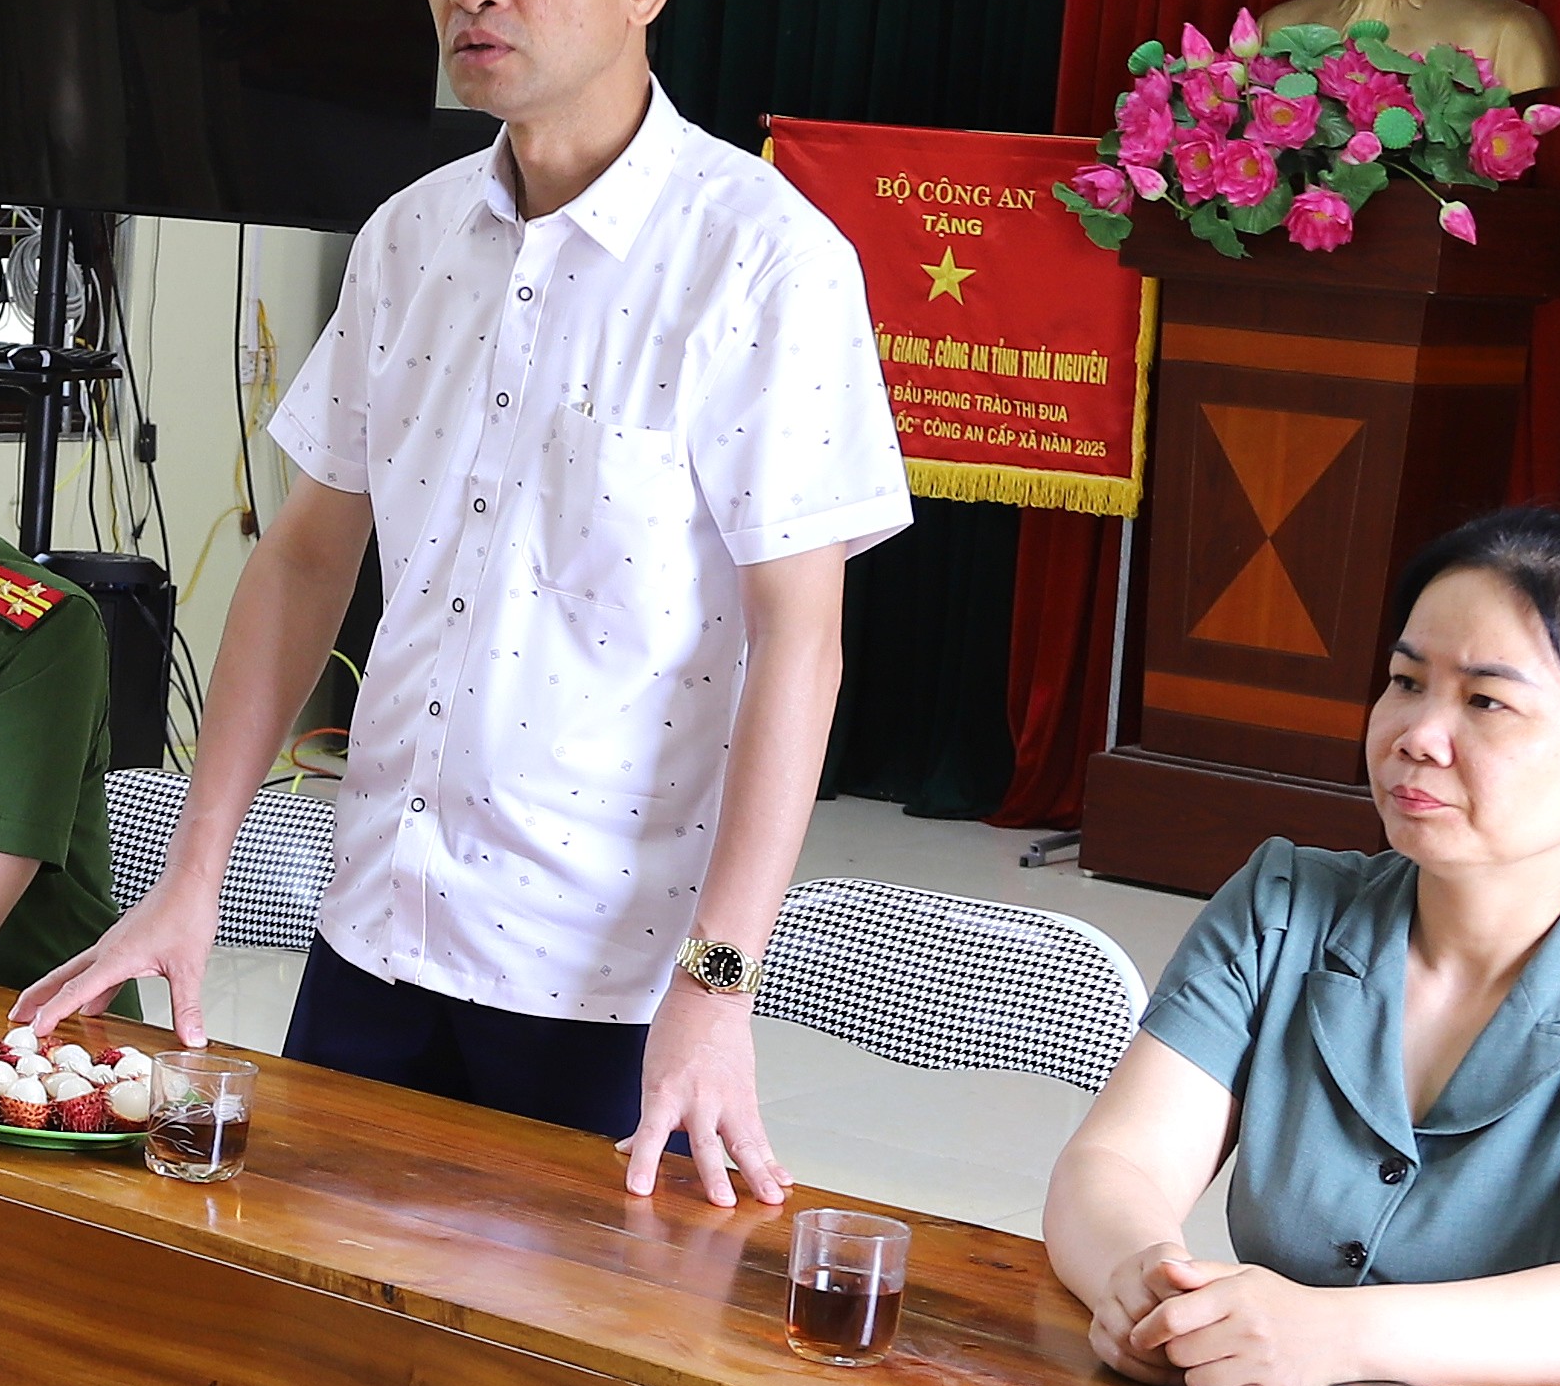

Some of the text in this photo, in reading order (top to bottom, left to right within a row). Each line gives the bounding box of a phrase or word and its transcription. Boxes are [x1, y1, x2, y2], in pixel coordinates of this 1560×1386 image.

[876, 172, 1036, 210] BỘ CÔNG AN
[922, 212, 983, 237] TẶNG
[935, 335, 969, 370] CÔNG
[971, 345, 990, 371] AN
[1022, 345, 1052, 380] THÁI
[1053, 350, 1109, 385] NGUYÊN
[893, 379, 922, 404] ĐẦU
[923, 388, 971, 410] PHONG
[974, 393, 1012, 415] TRÀO
[1013, 400, 1036, 419] THI
[1038, 403, 1069, 423] ĐUA
[923, 416, 961, 440] CÔNG
[964, 425, 985, 443] AN
[987, 422, 1017, 446] CẤP
[1018, 428, 1037, 449] XÃ
[1040, 432, 1073, 453] NĂM
[1074, 439, 1107, 458] 2025
